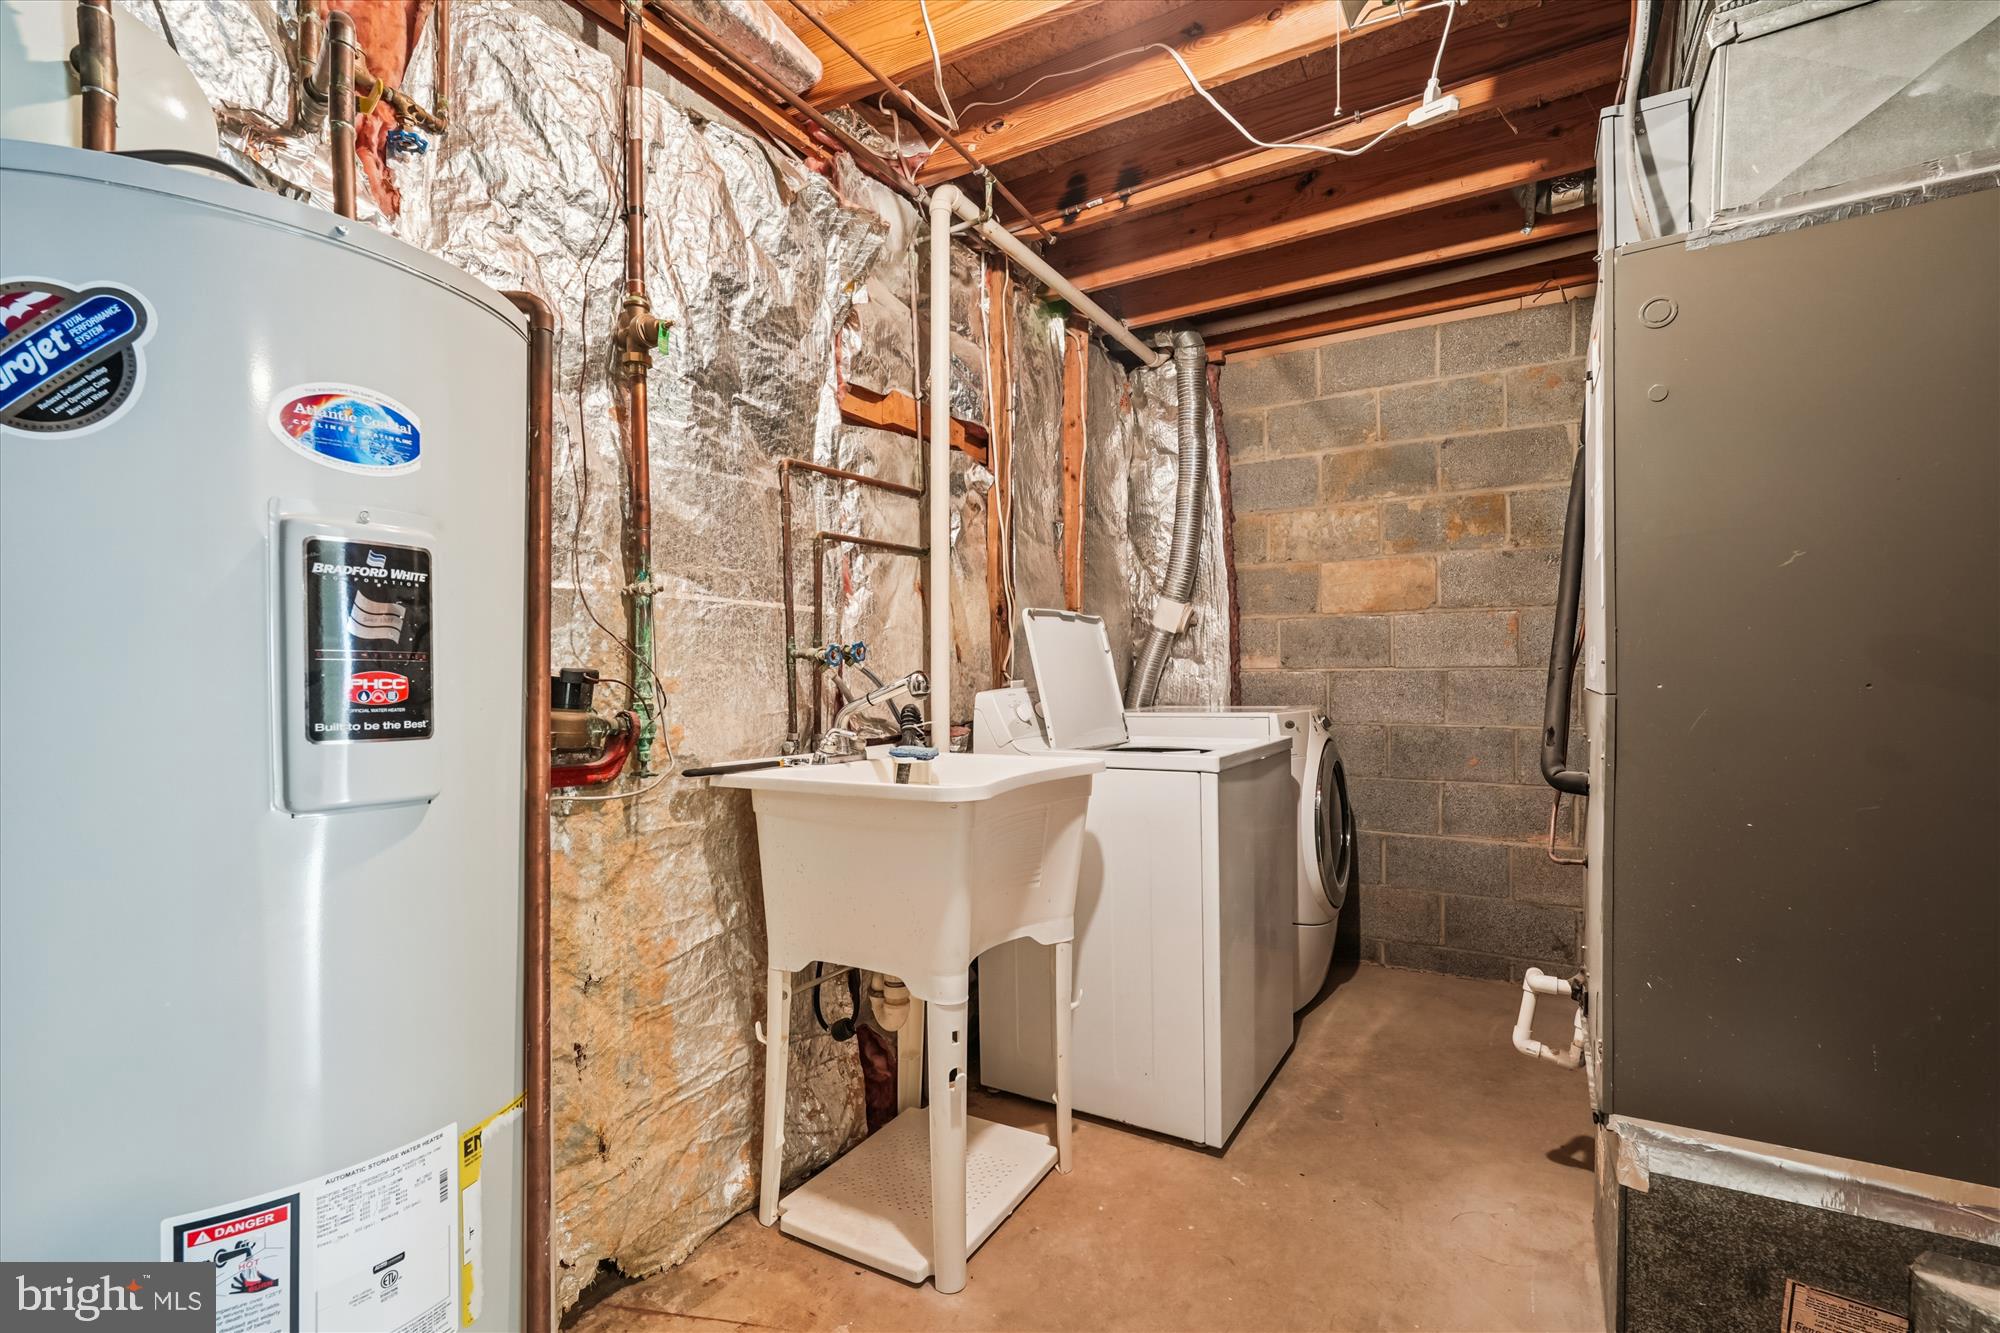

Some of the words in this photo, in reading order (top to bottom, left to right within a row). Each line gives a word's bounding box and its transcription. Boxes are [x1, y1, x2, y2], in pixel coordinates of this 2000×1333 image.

[62, 313, 87, 330] TOTAL
[68, 304, 122, 337] PERFORMANCE
[74, 325, 104, 346] SYSTEM
[32, 358, 93, 397] FEATURING
[37, 393, 62, 411] Reduced
[61, 375, 88, 396] Sediment
[50, 398, 69, 414] Lower
[67, 383, 97, 404] Operating
[92, 377, 111, 390] Costs
[66, 402, 84, 416] More
[81, 397, 94, 408] Hot
[91, 388, 110, 402] Water
[293, 403, 357, 423] Atlantic
[312, 562, 388, 578] BRADFORD
[390, 569, 428, 583] WHITE
[322, 575, 420, 588] COPORATION
[349, 678, 406, 690] PHCC
[348, 722, 360, 732] to
[364, 722, 380, 731] be
[382, 720, 402, 730] the
[403, 719, 426, 729] Best
[325, 1166, 367, 1185] AUTOMATIC
[367, 1153, 399, 1170] STORAGE
[401, 1143, 421, 1156] WATER
[422, 1133, 444, 1147] HEATER
[214, 1212, 275, 1239] DANGER
[238, 1259, 260, 1271] HOT
[1848, 1303, 1879, 1317] NOTICE
